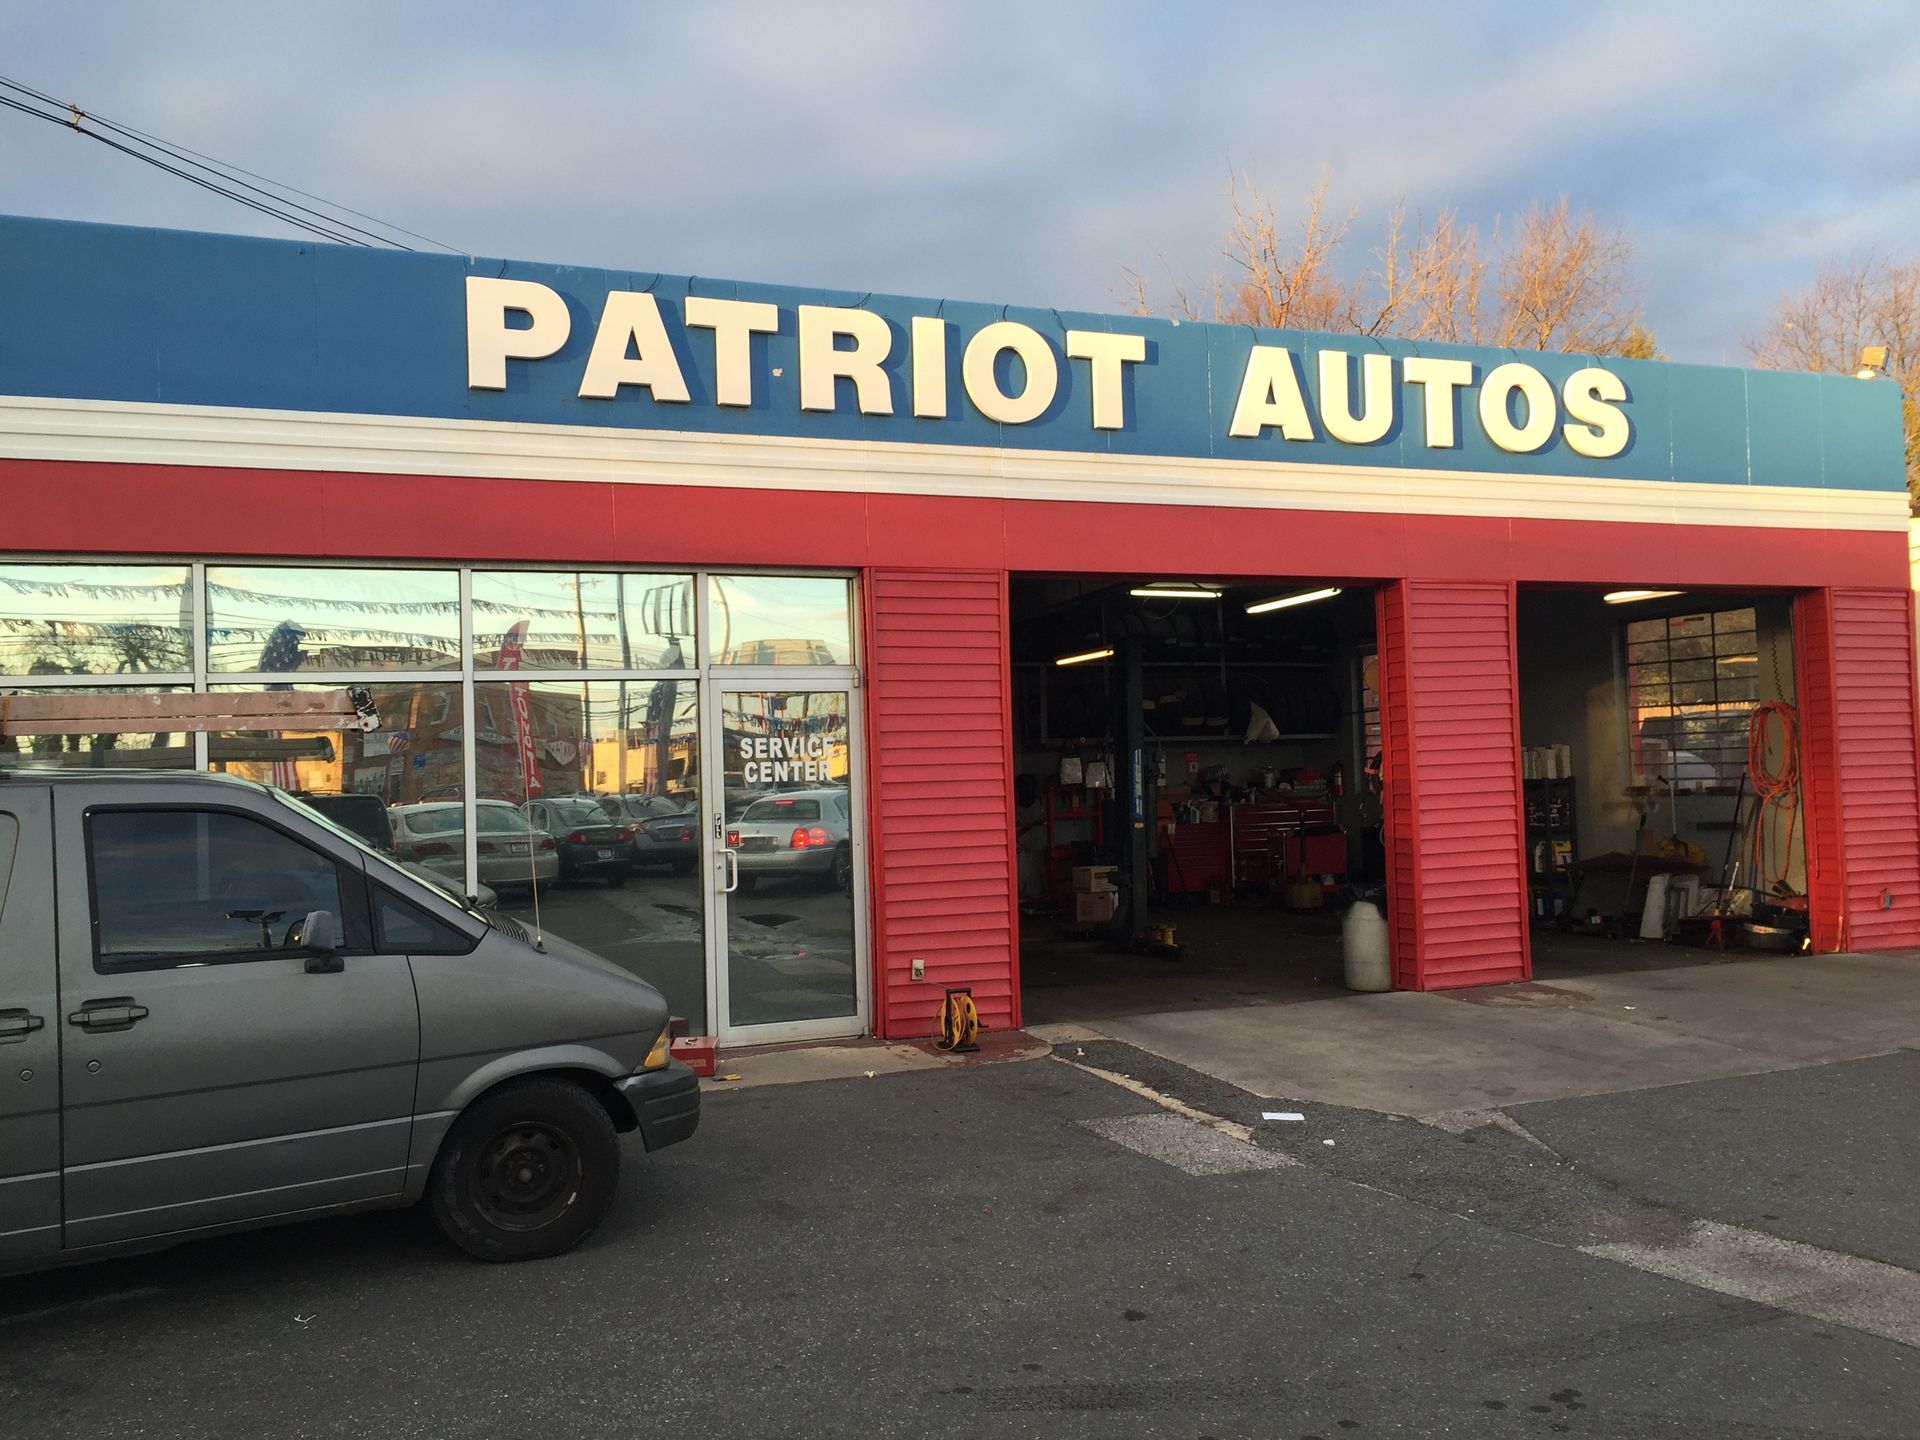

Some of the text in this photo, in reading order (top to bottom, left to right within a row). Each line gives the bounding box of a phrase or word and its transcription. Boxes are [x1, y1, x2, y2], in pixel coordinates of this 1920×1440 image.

[466, 276, 1629, 458] PATRIOT AUTOS
[740, 737, 836, 759] SERVICE
[744, 761, 832, 783] CENTER
